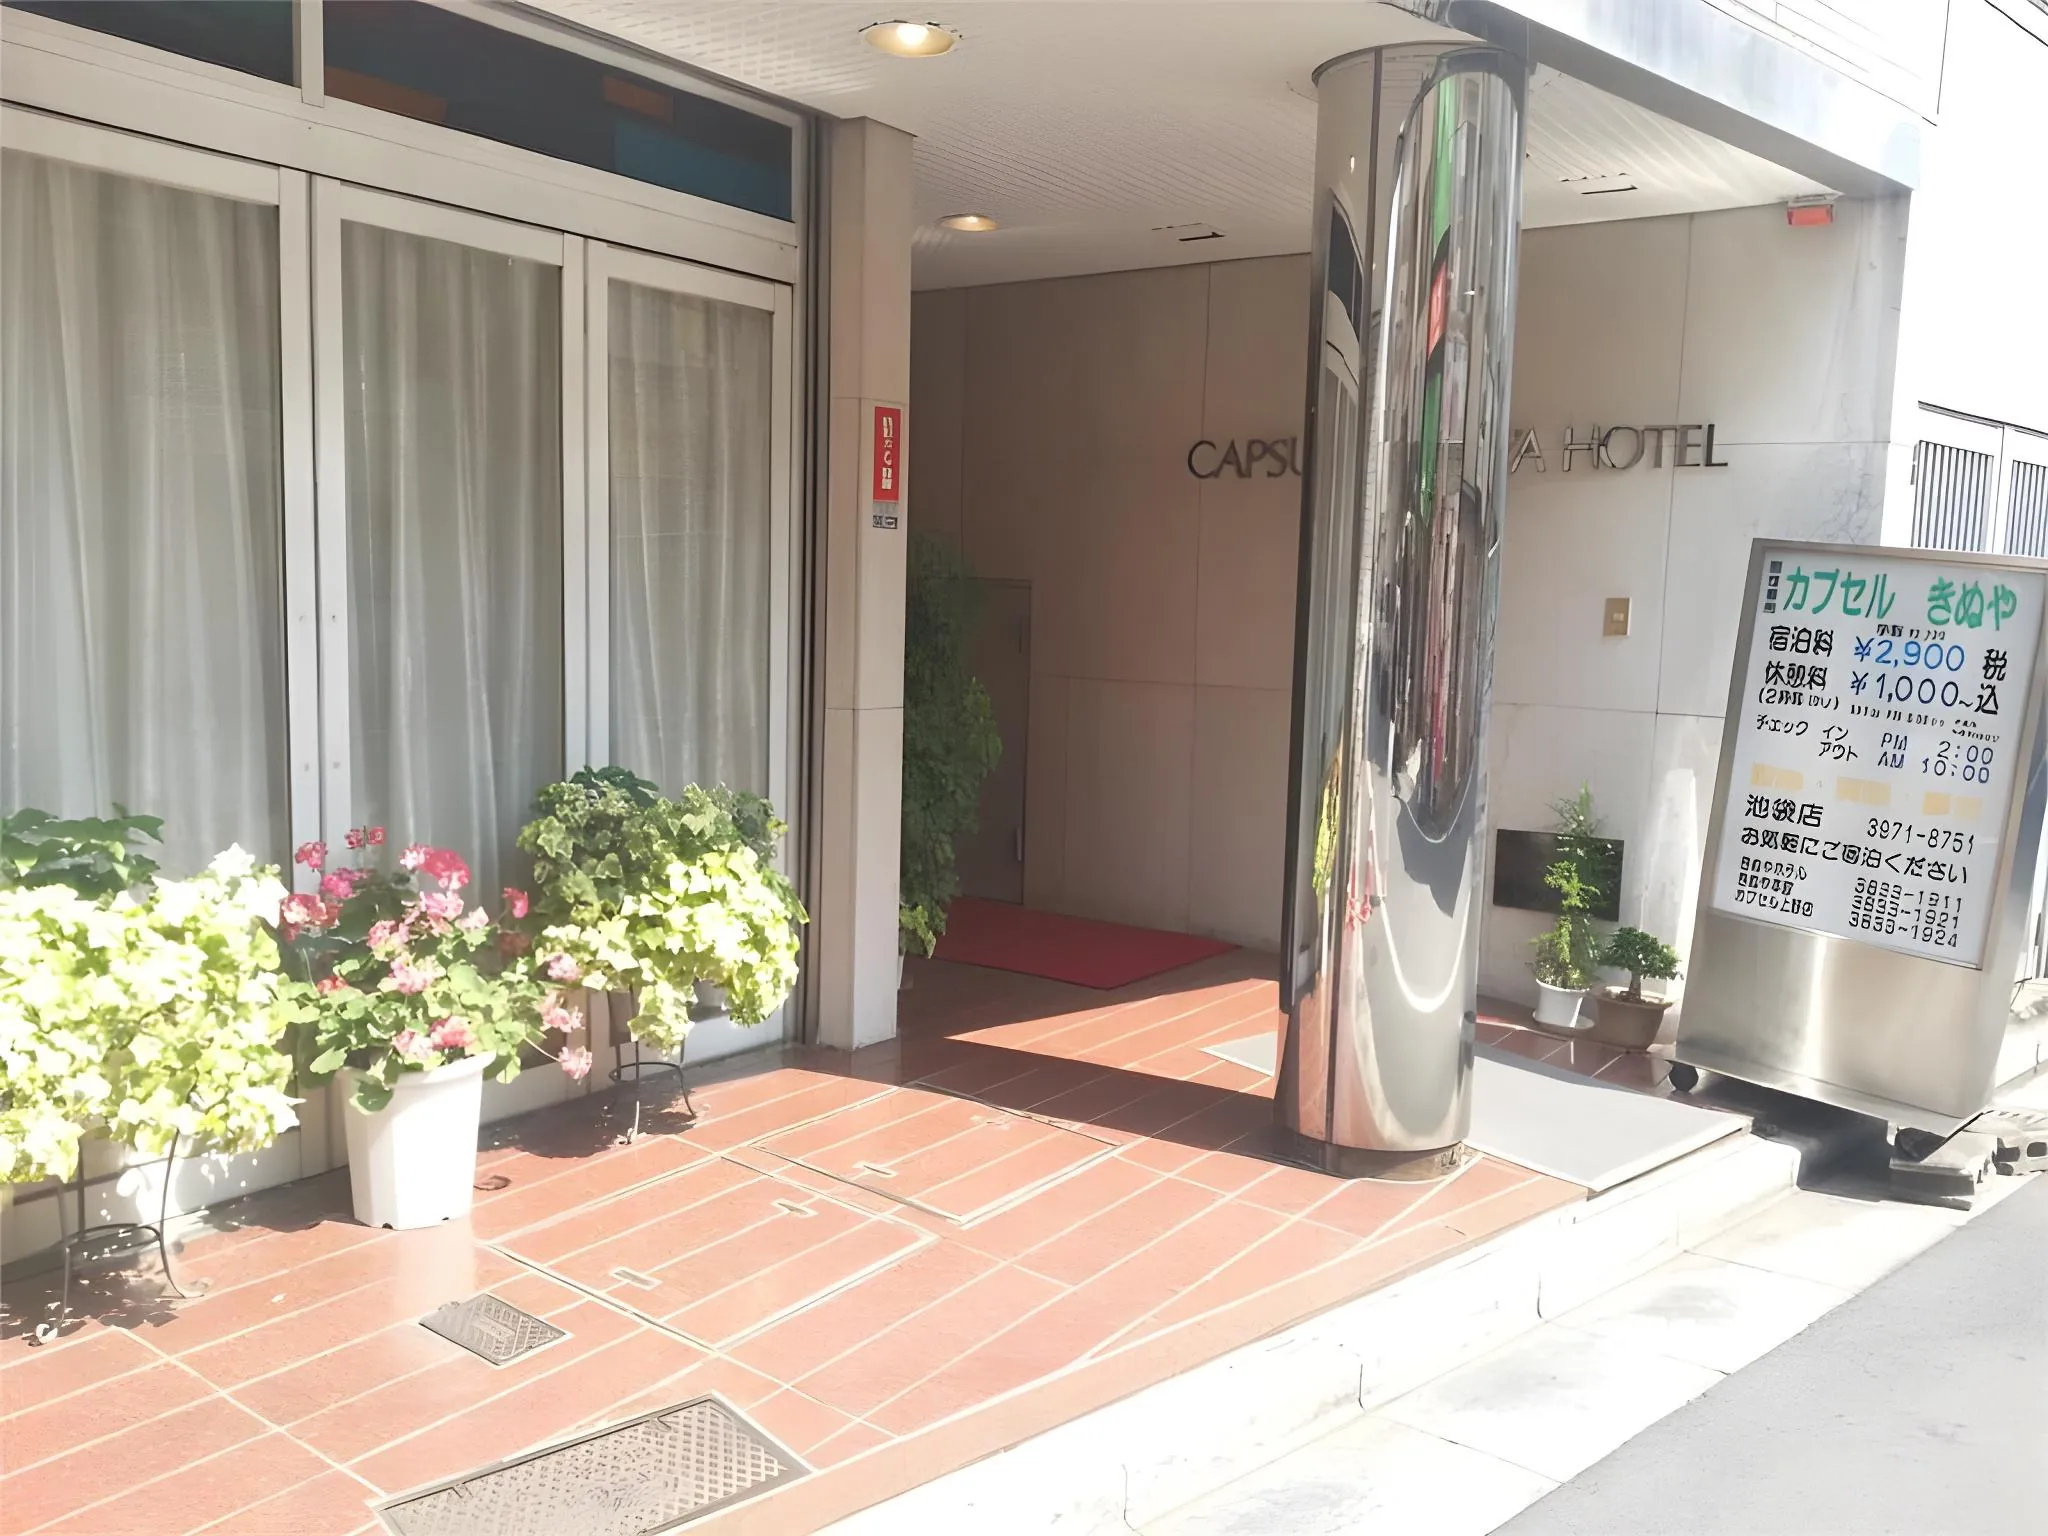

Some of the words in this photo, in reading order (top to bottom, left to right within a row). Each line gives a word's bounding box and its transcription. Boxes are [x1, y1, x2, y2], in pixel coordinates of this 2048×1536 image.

[1561, 423, 1728, 472] HOTEL
[1926, 576, 2017, 631] きぬや
[1854, 636, 1965, 672] ¥2,900
[1818, 741, 1859, 761] アウト
[1878, 751, 1905, 769] AM
[1922, 757, 1990, 784] 10:00
[1822, 724, 1849, 741] イン
[1880, 732, 1908, 751] PM
[1936, 740, 1994, 765] 2:00
[1866, 817, 1975, 855] 3971-8751
